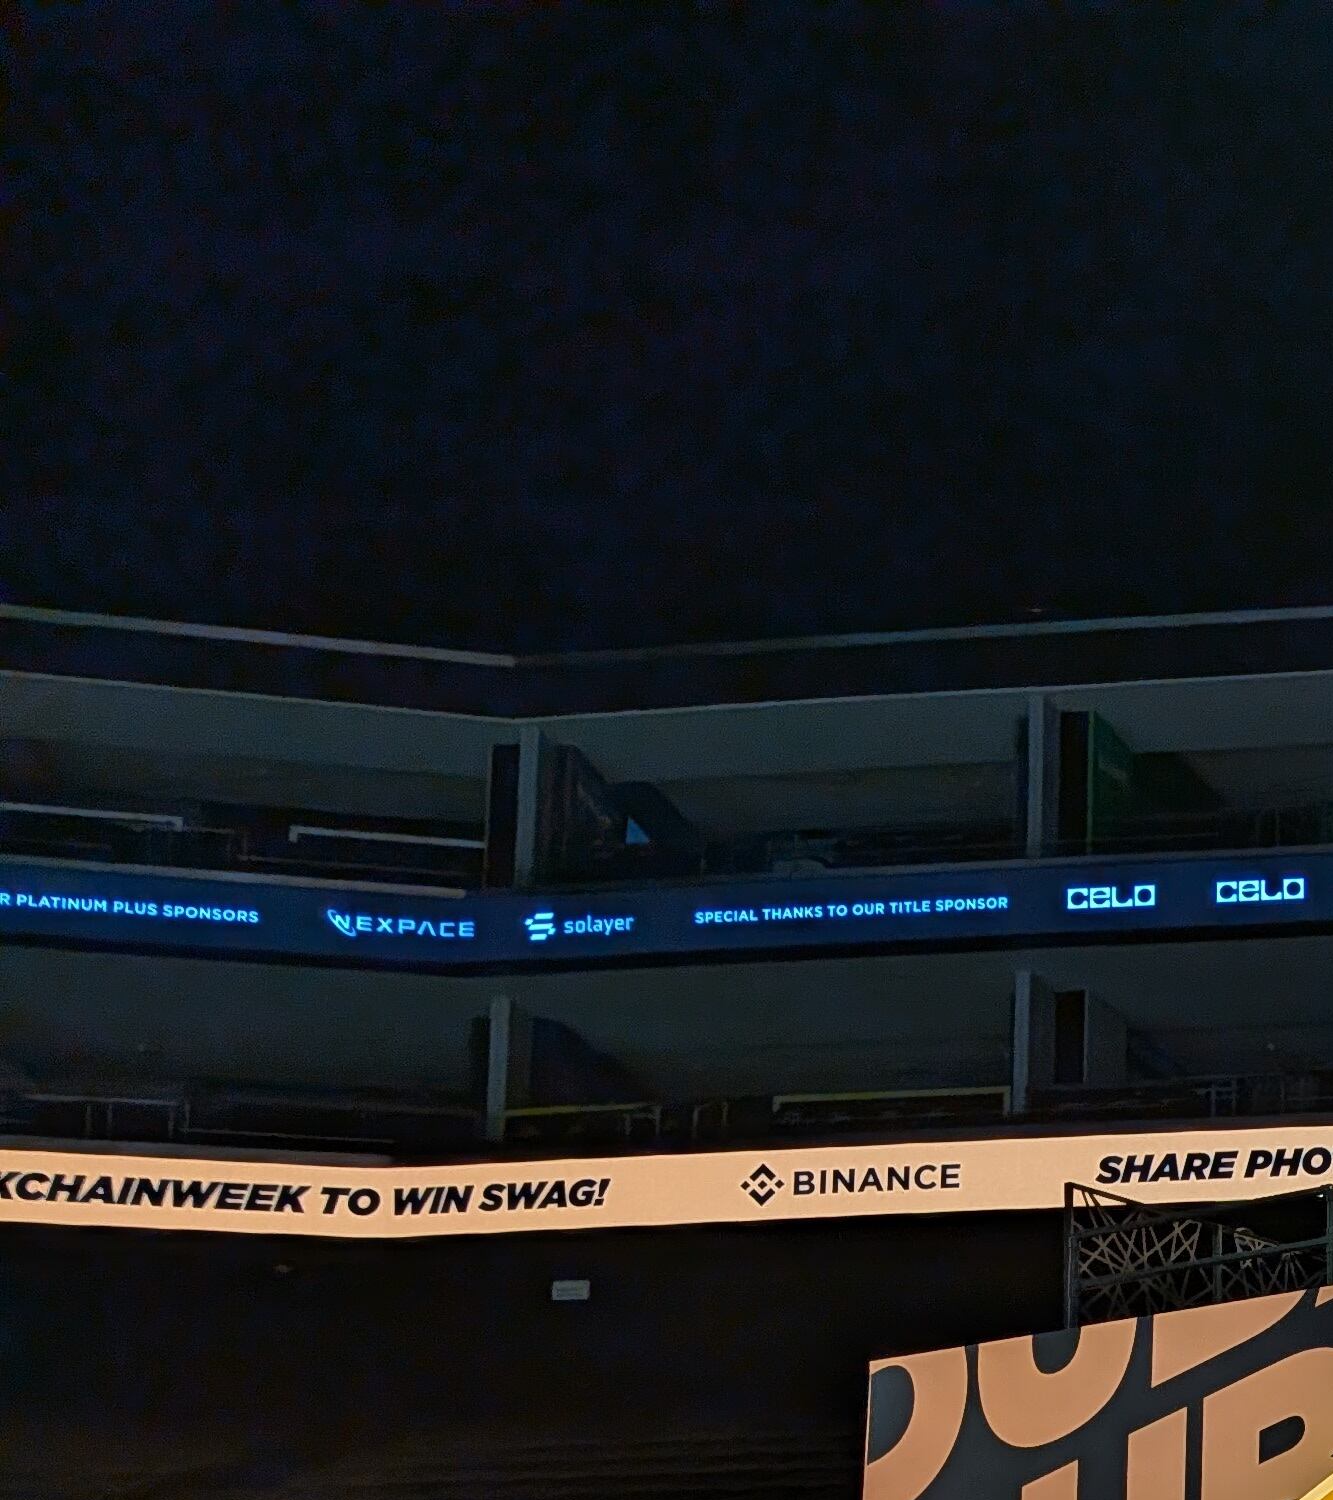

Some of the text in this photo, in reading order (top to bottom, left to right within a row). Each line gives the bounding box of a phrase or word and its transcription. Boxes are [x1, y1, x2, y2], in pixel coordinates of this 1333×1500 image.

[16, 893, 108, 913] PLATINUM
[113, 900, 158, 917] PLUS
[162, 904, 259, 924] SPONSORS
[327, 909, 475, 937] NEXPACE
[695, 896, 1009, 925] SPECIAL THANKS TO OUR TITLE SPONSOR
[563, 914, 635, 936] solayer
[793, 1163, 961, 1196] BINANCE
[1096, 1151, 1238, 1184] SHARE
[320, 1186, 381, 1216] TO
[393, 1184, 474, 1216] WIN
[479, 1177, 611, 1212] SWAG!
